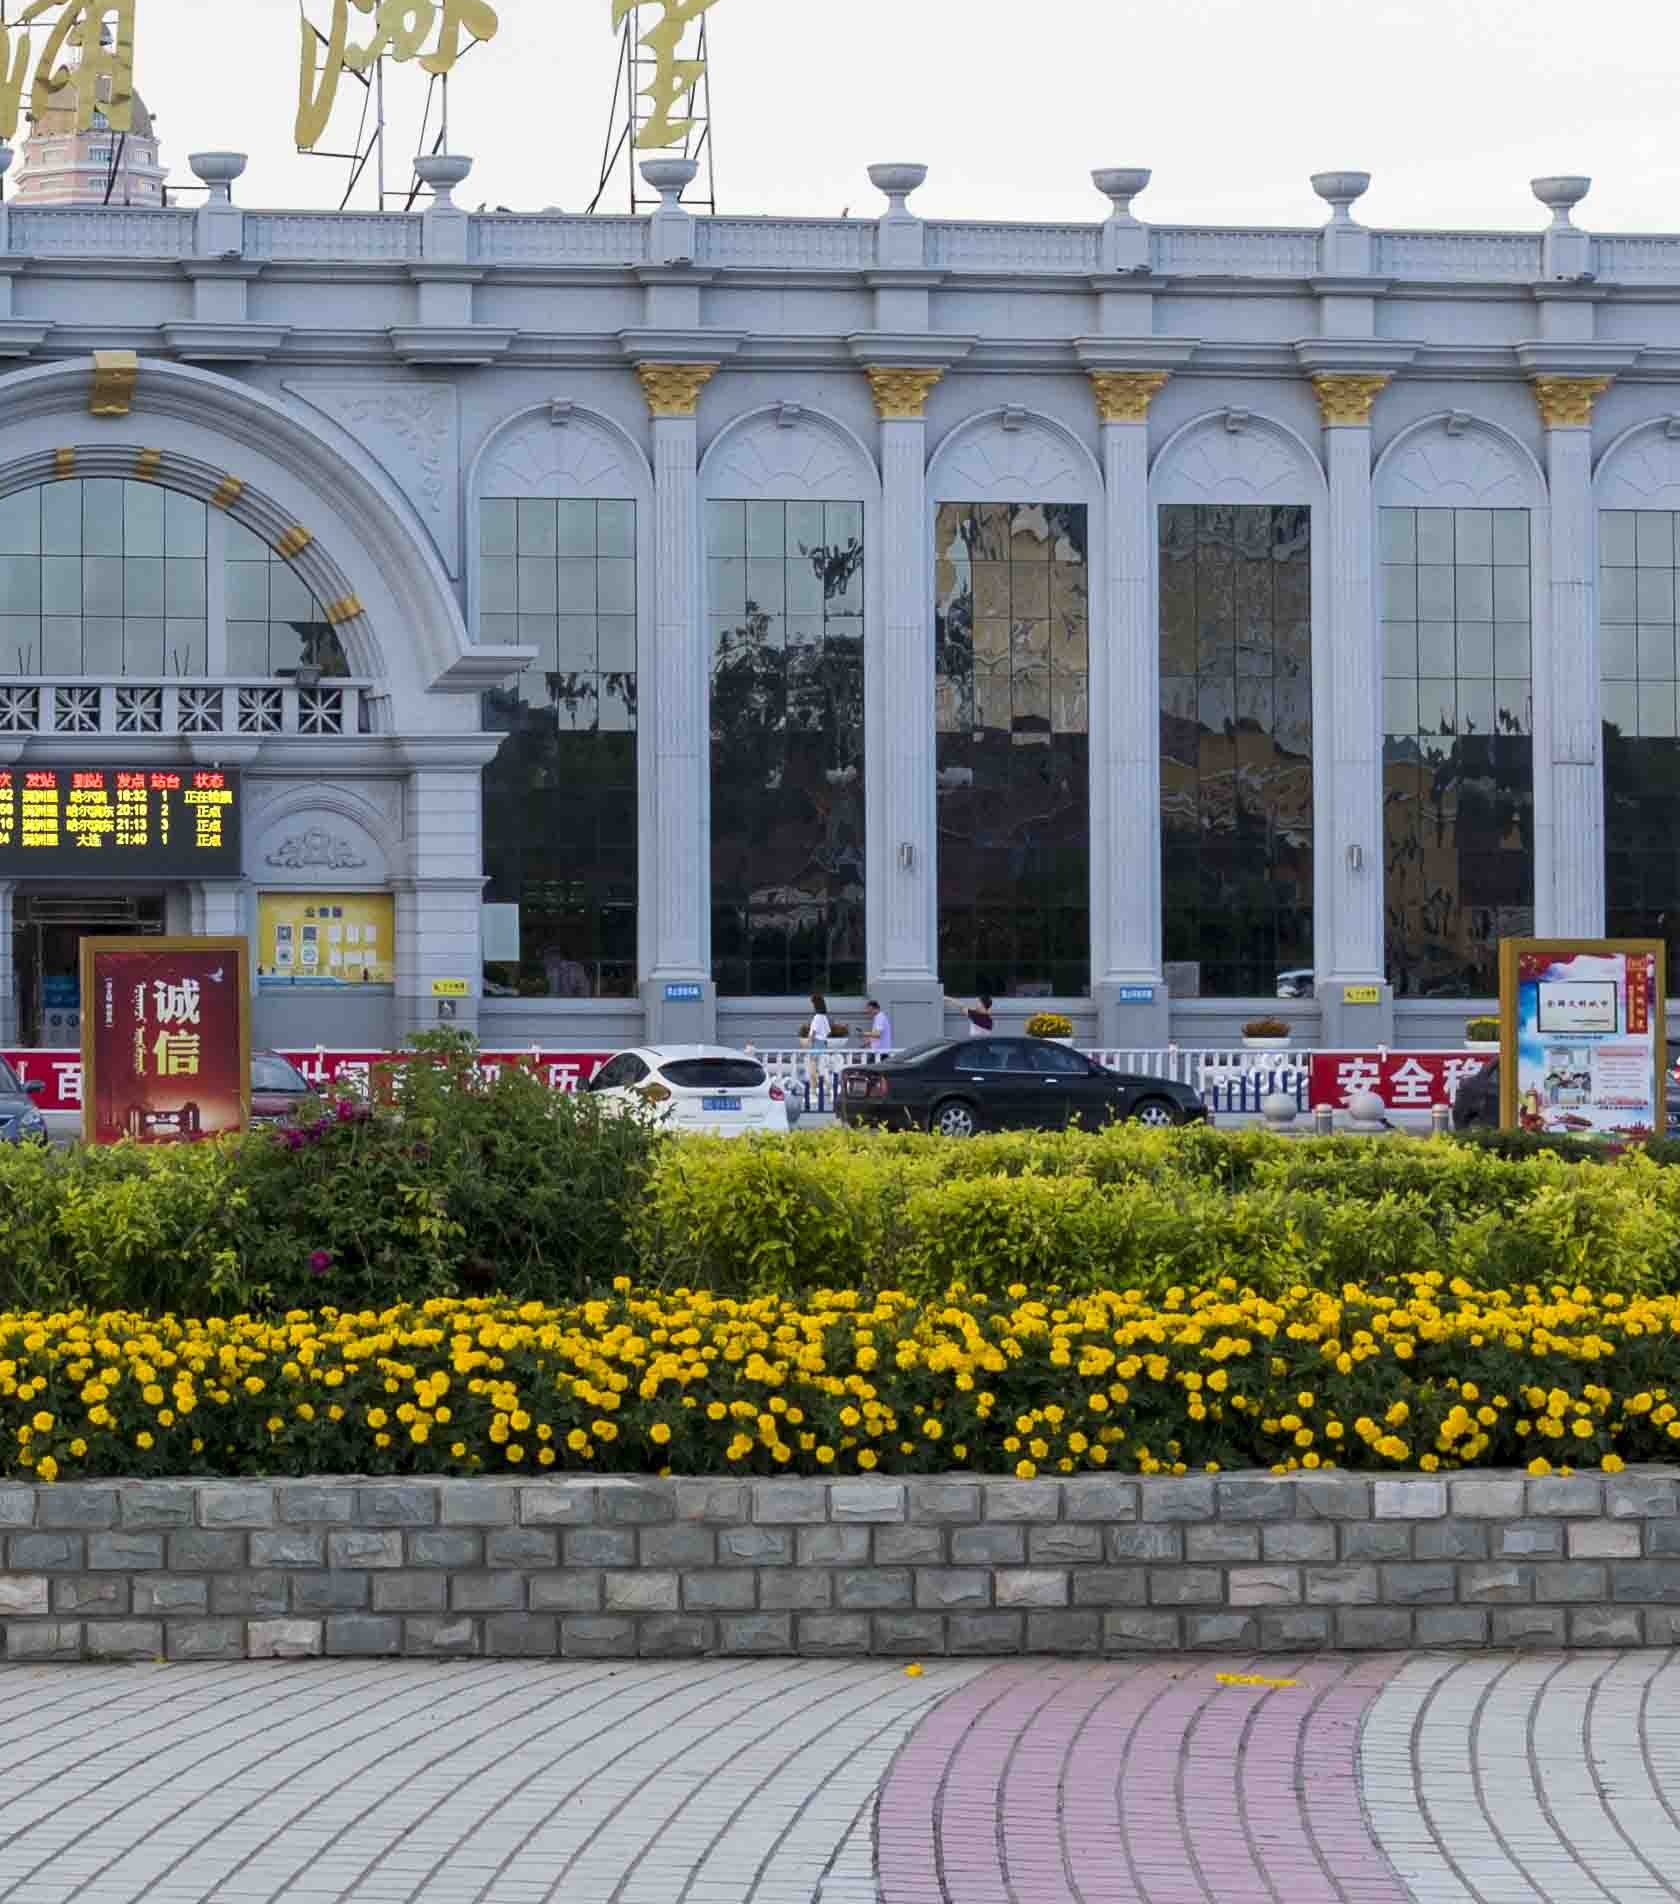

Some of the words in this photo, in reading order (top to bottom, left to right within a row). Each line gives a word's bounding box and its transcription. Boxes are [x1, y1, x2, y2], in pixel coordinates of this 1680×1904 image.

[151, 774, 181, 789] 站台
[194, 773, 224, 789] 状态
[152, 977, 201, 1076] 诚信
